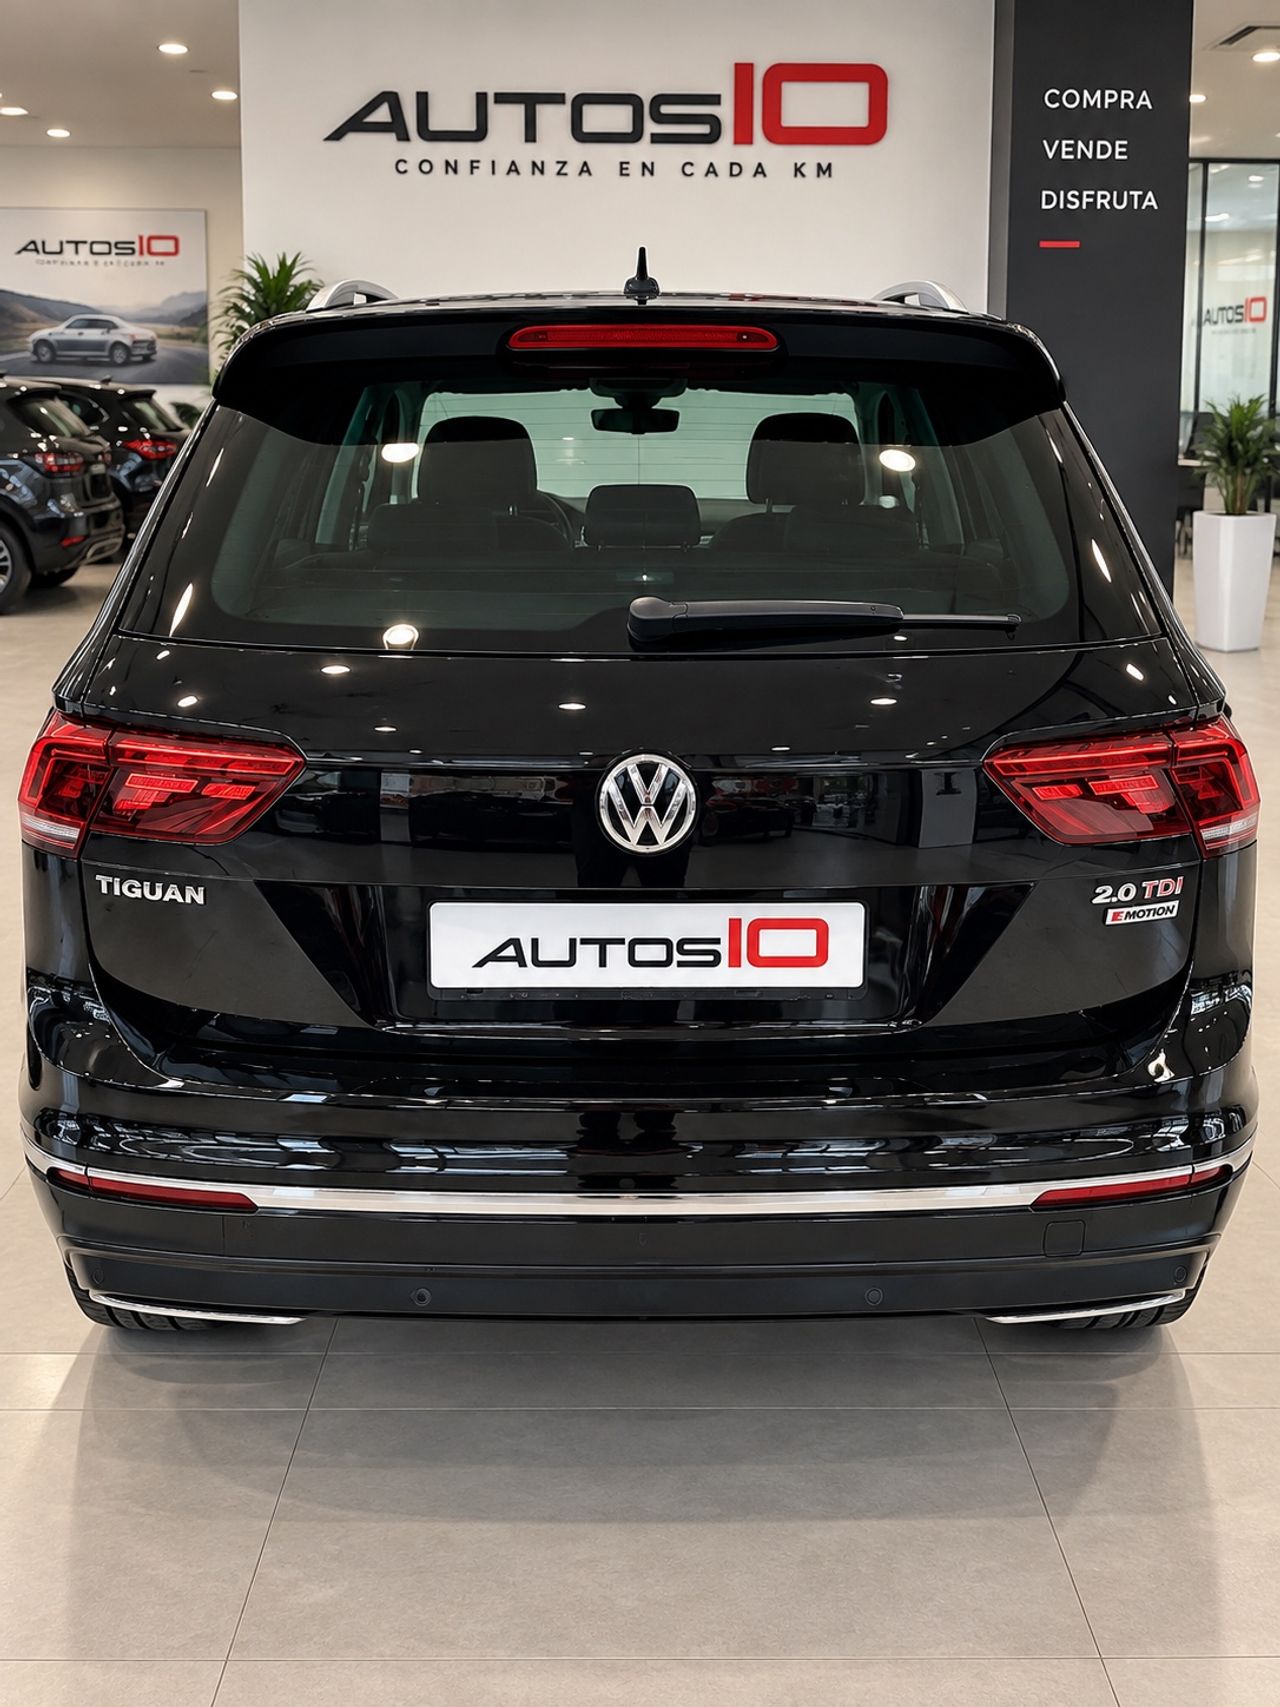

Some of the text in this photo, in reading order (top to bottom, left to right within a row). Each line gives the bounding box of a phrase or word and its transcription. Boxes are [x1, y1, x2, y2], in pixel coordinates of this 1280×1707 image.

[1044, 89, 1153, 110] COMPRA
[1043, 139, 1129, 160] VENDE
[394, 158, 834, 178] CONFIANZA EN CADA KM
[1040, 190, 1159, 210] DISFRUTA
[95, 874, 205, 905] TIGUAN
[1091, 876, 1185, 904] 2.0 TDI
